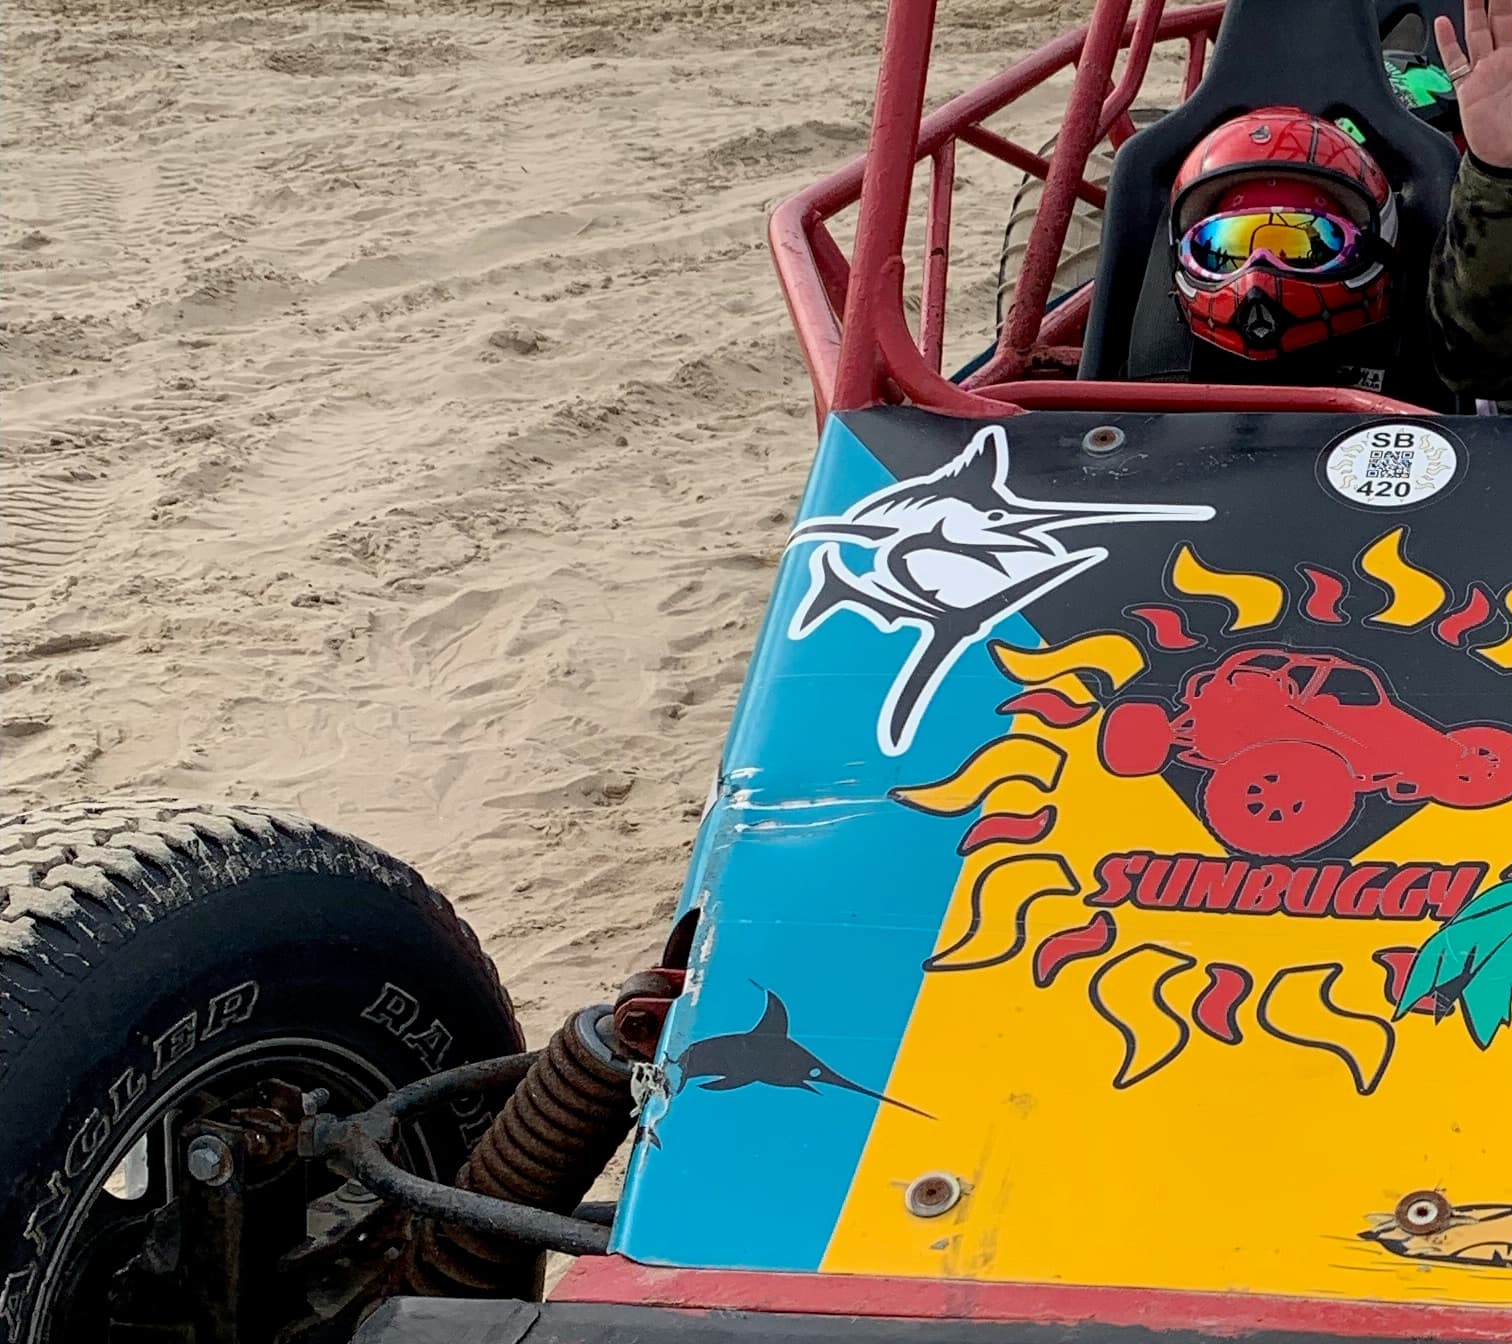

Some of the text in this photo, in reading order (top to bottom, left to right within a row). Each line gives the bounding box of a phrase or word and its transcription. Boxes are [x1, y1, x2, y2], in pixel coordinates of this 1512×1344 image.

[1371, 432, 1415, 448] SB
[1356, 480, 1411, 498] 420
[1086, 852, 1485, 925] SUNBUGGY
